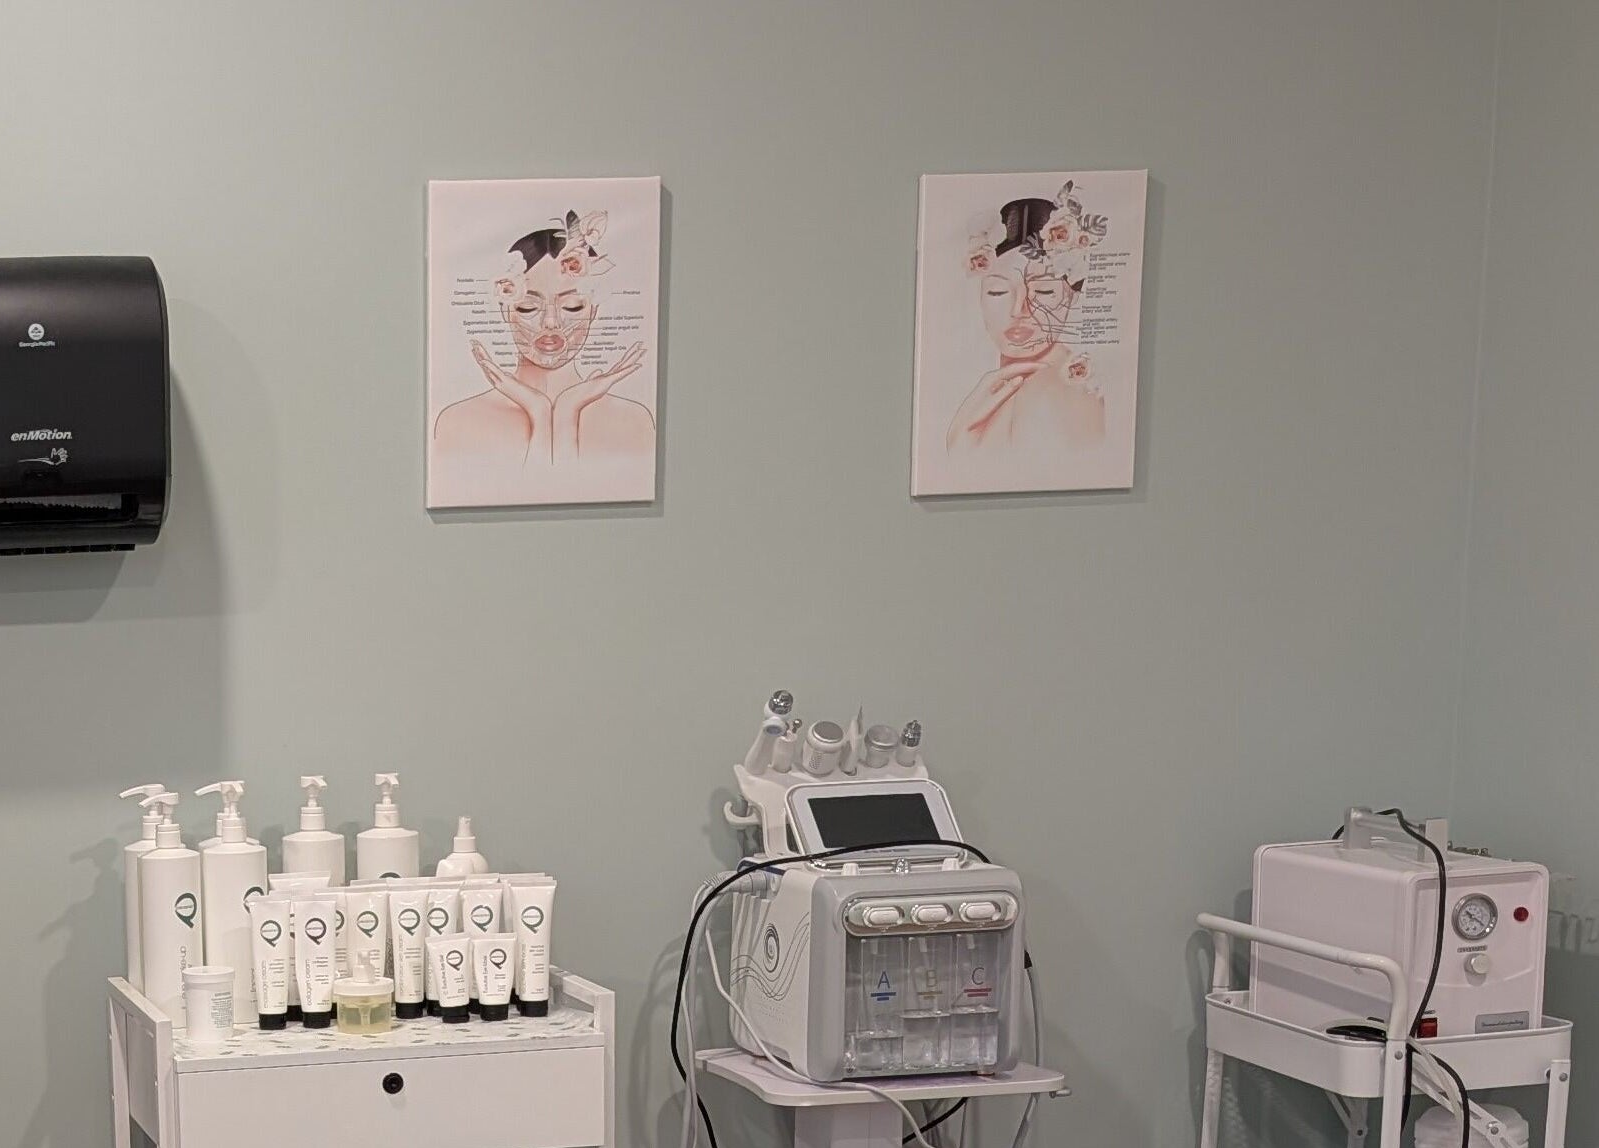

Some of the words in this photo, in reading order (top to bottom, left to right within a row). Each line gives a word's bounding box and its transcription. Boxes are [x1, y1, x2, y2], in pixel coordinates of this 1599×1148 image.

[10, 429, 72, 442] enMotion
[877, 971, 890, 989] A
[926, 969, 937, 987] B
[972, 967, 985, 985] C
